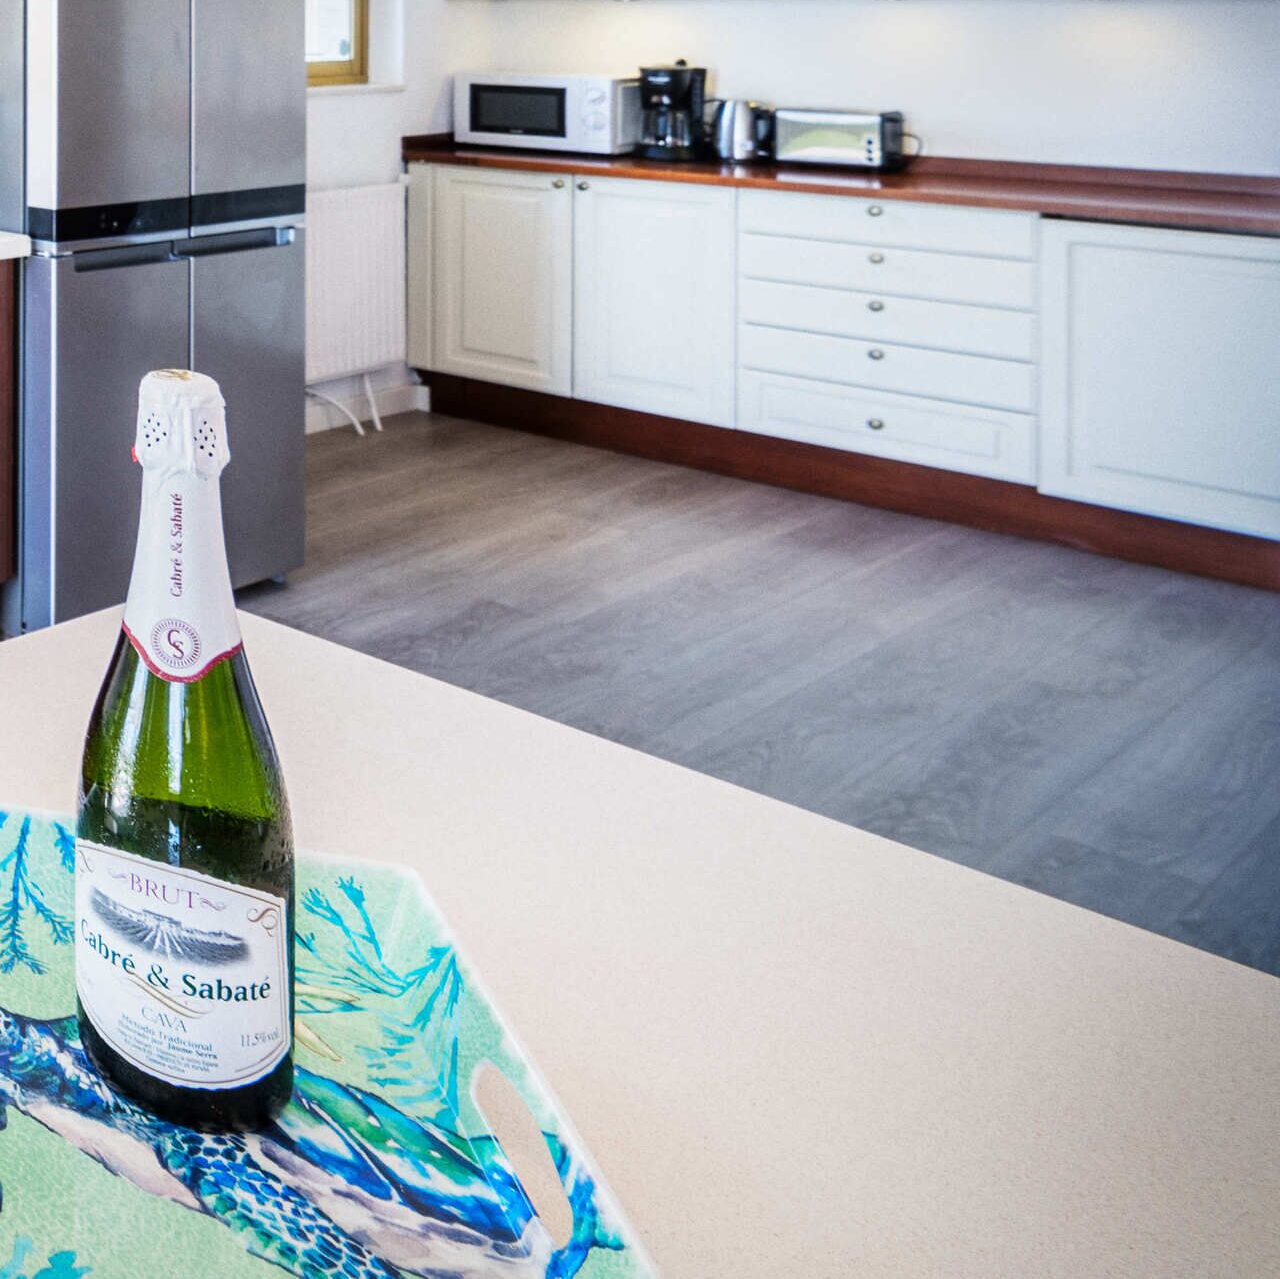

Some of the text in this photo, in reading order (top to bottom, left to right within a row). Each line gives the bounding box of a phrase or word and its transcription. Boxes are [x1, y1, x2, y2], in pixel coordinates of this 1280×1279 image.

[170, 492, 184, 538] Sabaté
[171, 542, 184, 554] &
[130, 872, 201, 909] BRUT
[80, 918, 272, 1003] Cabré & Sabaté
[141, 1007, 188, 1034] CAVA
